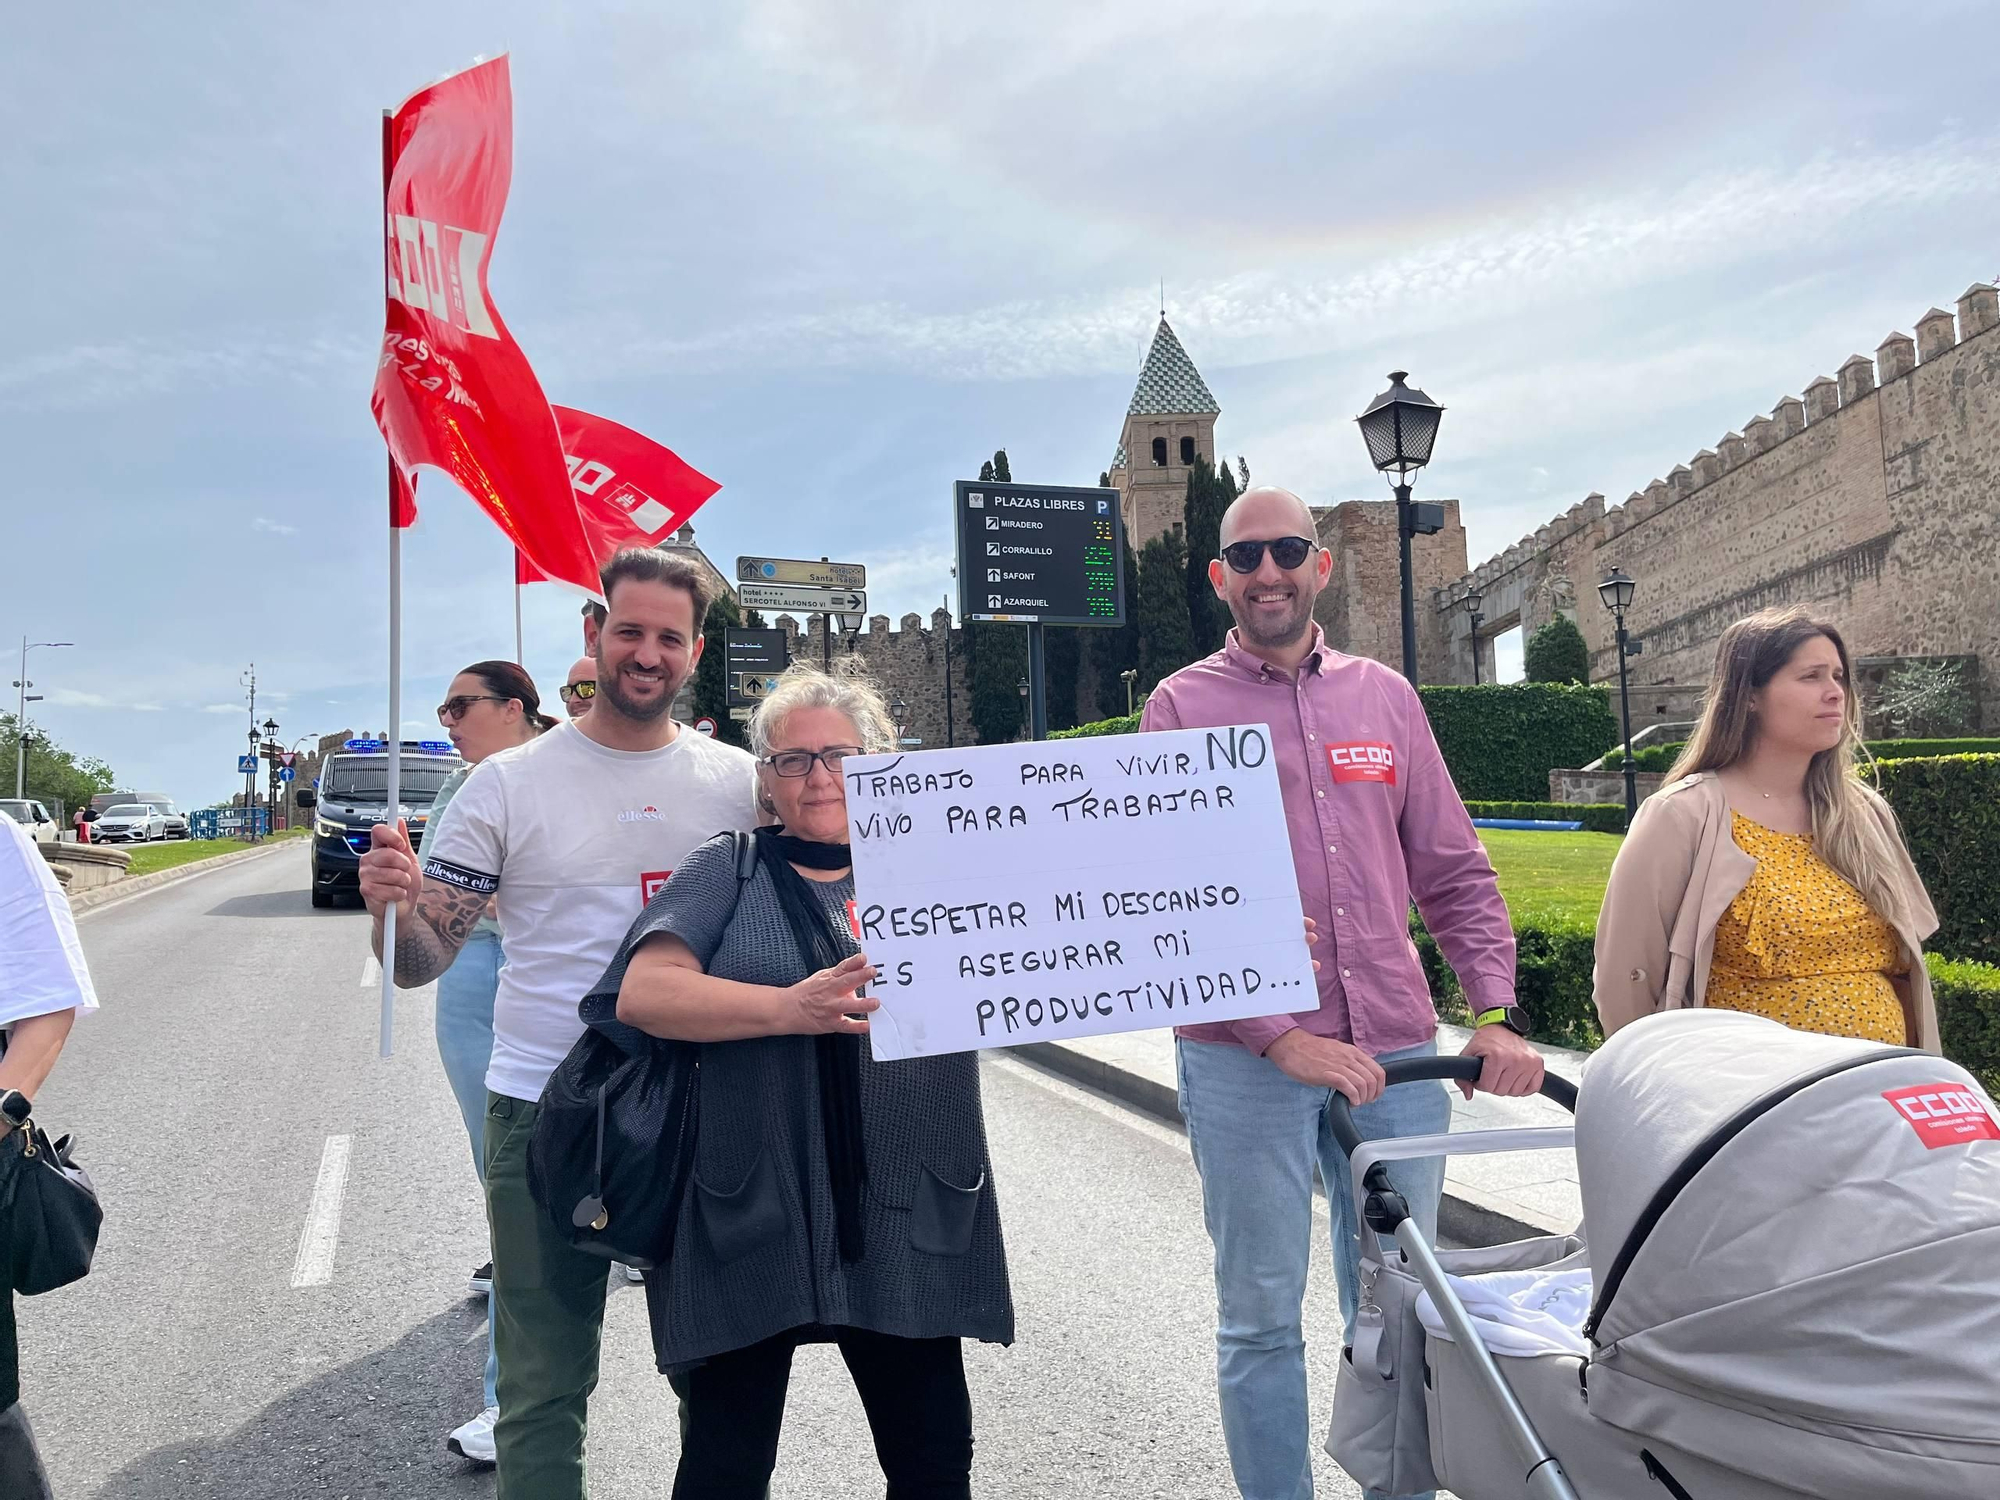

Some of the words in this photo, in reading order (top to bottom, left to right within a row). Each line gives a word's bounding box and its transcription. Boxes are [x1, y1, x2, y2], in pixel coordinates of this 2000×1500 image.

[994, 496, 1041, 509] PLAZAS
[1043, 499, 1085, 511] LIBRES
[1097, 501, 1108, 514] P
[1000, 520, 1044, 530] MIRADERO
[1002, 546, 1053, 556] CORRALILLO
[809, 574, 834, 583] Santa
[1003, 572, 1036, 581] SAFONT
[743, 597, 783, 606] SERCOTEL
[783, 600, 818, 608] ALFONSO
[1003, 598, 1049, 608] AZARQUIEL
[847, 756, 973, 797] TRABAJO
[1021, 763, 1084, 786] PARA
[1206, 727, 1266, 770] NO
[1331, 747, 1393, 766] CCOO
[617, 811, 666, 821] ellesse
[947, 805, 1027, 834] PARA
[1052, 785, 1235, 822] TRABAJAR
[427, 863, 469, 884] ellesse
[861, 901, 1027, 941] RESPETAR
[872, 961, 913, 987] ES
[959, 940, 1124, 979] ASEGURAR
[1895, 1092, 1985, 1120] CCOO
